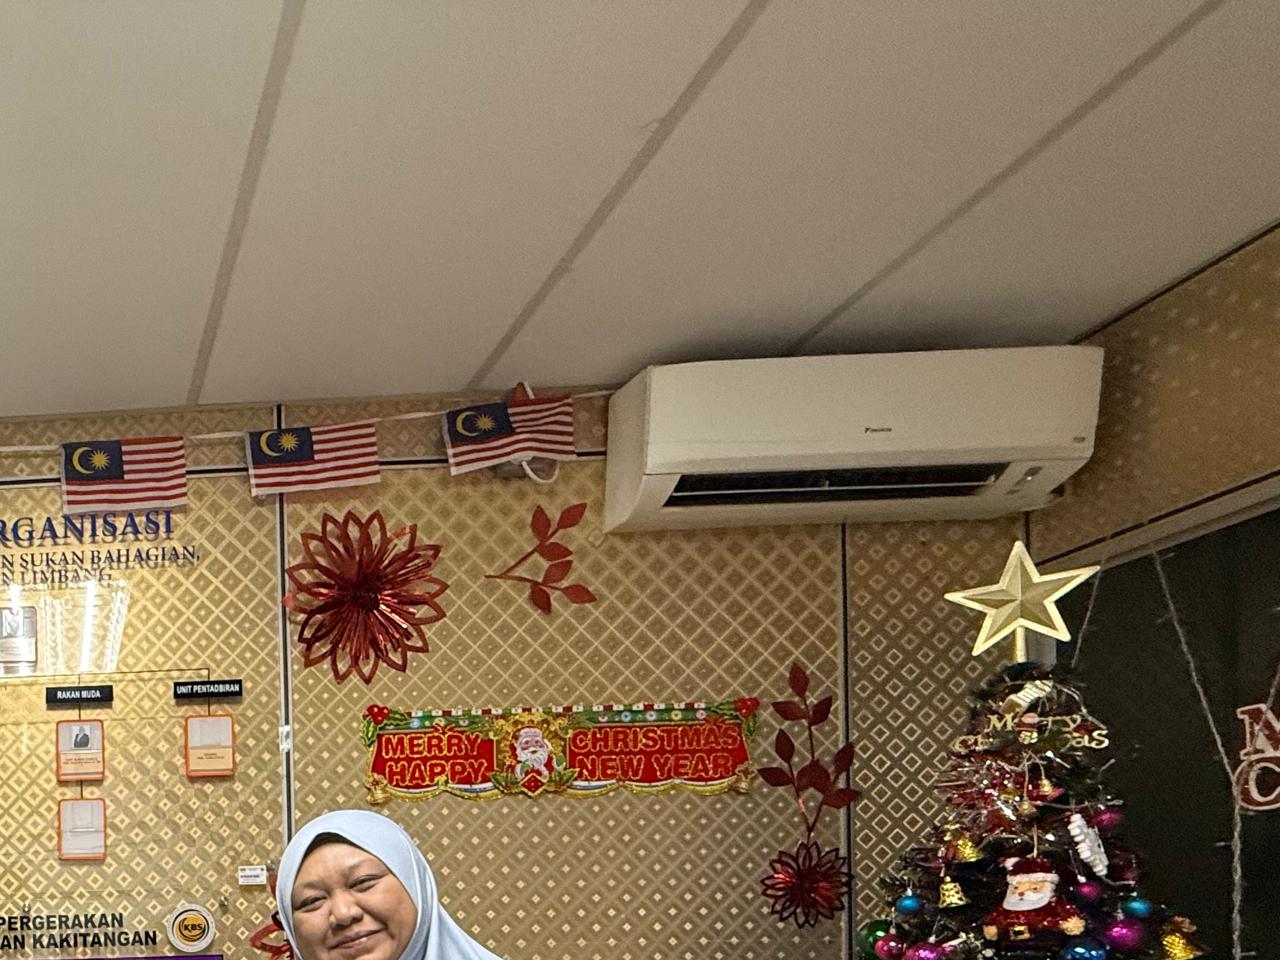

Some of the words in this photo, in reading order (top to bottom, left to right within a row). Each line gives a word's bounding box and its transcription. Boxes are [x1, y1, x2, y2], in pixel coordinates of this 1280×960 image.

[20, 551, 84, 569] SUKAN
[20, 567, 112, 586] LIMBANG
[57, 690, 80, 699] RAKAN
[81, 690, 101, 699] MUDA
[176, 685, 192, 694] UNIT
[193, 684, 240, 694] PENTADBIRAN
[382, 731, 481, 759] MERRY
[571, 724, 740, 753] CHRISTMAS
[385, 759, 488, 786] HAPPY
[575, 754, 645, 781] NEW
[651, 752, 733, 779] YEAR
[183, 923, 203, 933] KBS
[32, 929, 157, 949] KAKITANGAN
